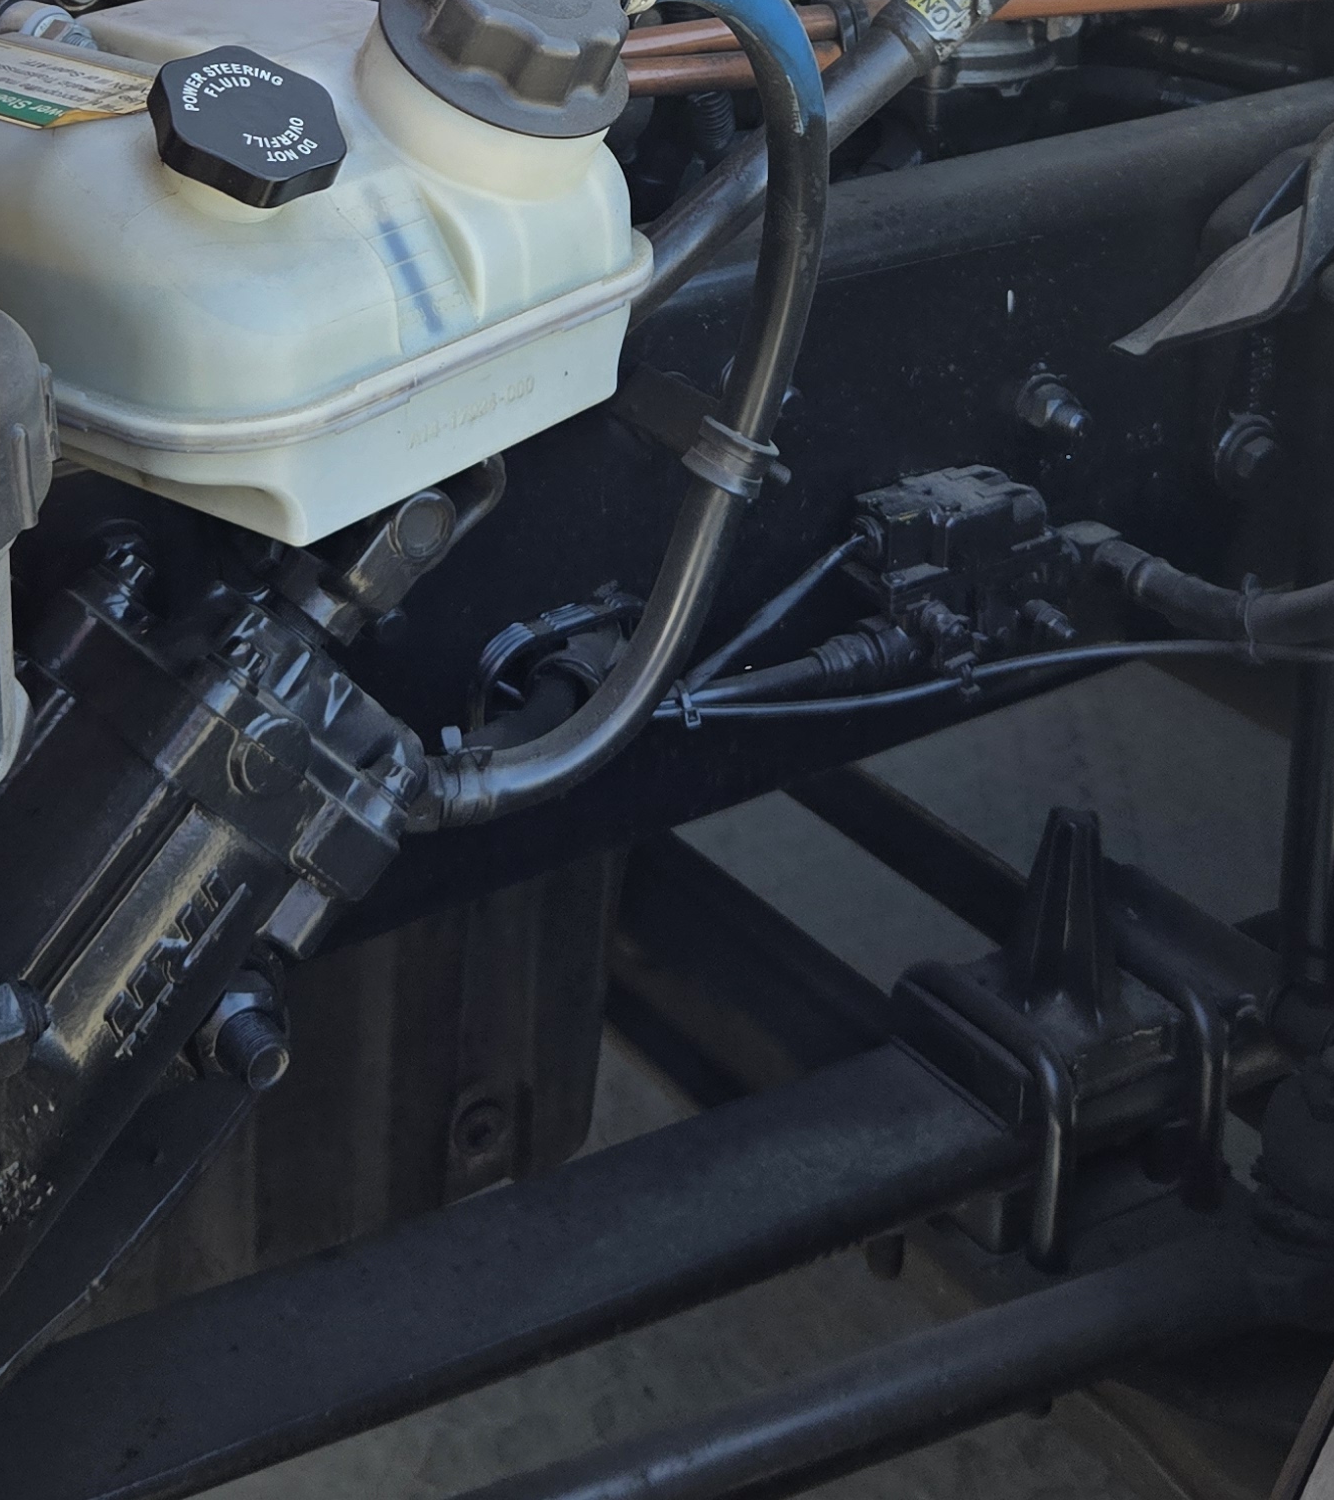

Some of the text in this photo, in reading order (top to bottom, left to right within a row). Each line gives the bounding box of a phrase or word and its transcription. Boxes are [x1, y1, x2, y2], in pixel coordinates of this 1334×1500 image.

[182, 72, 207, 112] POWER
[202, 63, 284, 86] STEERING
[203, 76, 251, 98] FLUID
[29, 102, 64, 117] wer
[242, 117, 304, 148] OVERFILL
[266, 137, 319, 163] DO NOT
